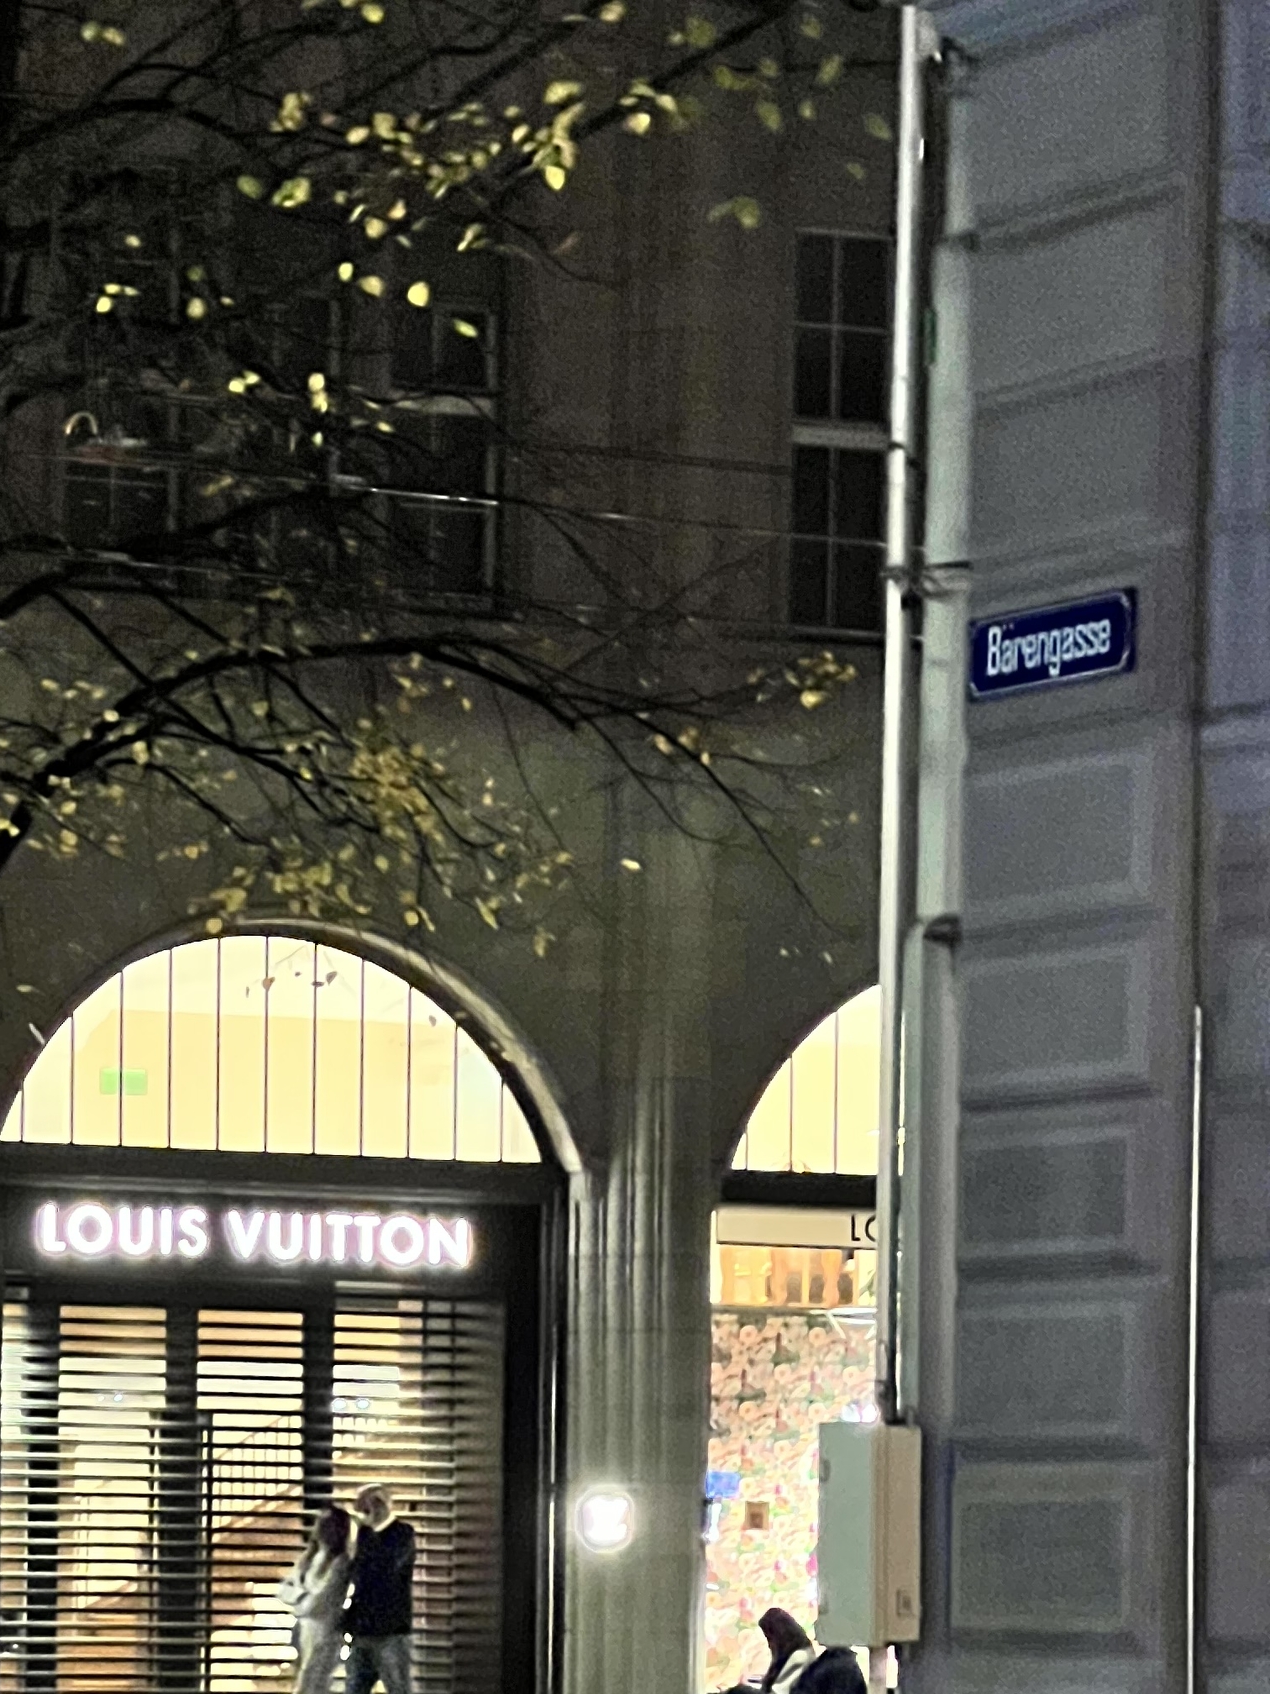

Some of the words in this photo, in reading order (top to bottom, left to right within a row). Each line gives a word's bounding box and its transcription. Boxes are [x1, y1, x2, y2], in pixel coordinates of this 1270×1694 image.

[986, 618, 1112, 677] Bärengasse
[39, 1202, 209, 1257] LOUIS
[227, 1208, 473, 1269] VUITTON
